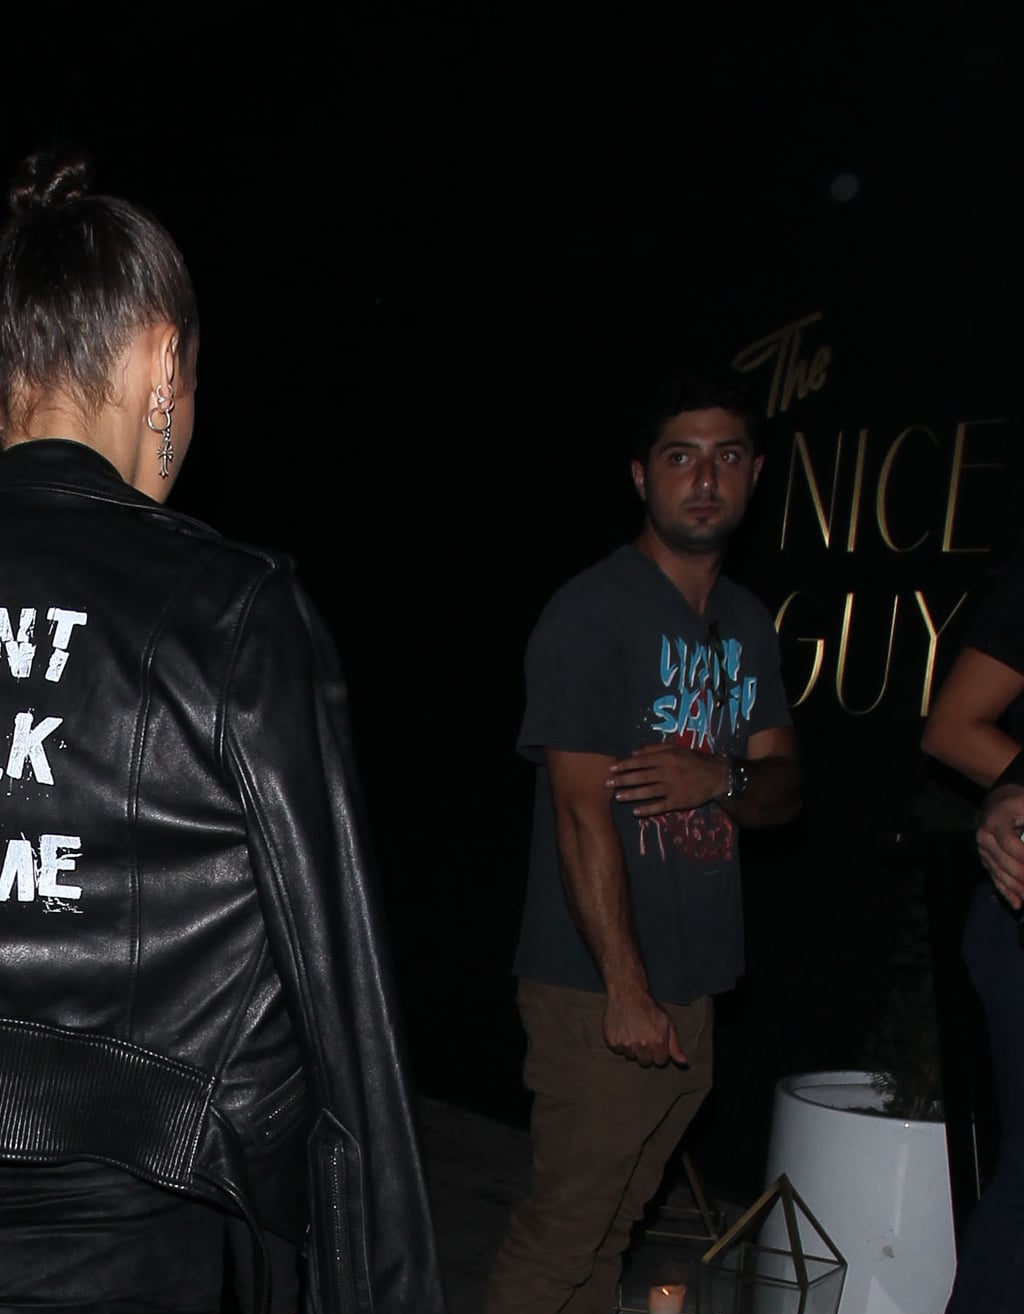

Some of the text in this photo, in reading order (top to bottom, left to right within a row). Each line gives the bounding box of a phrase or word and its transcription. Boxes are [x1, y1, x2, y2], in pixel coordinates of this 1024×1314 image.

[732, 311, 833, 418] The
[780, 418, 1008, 553] NICE
[775, 588, 969, 718] GUY
